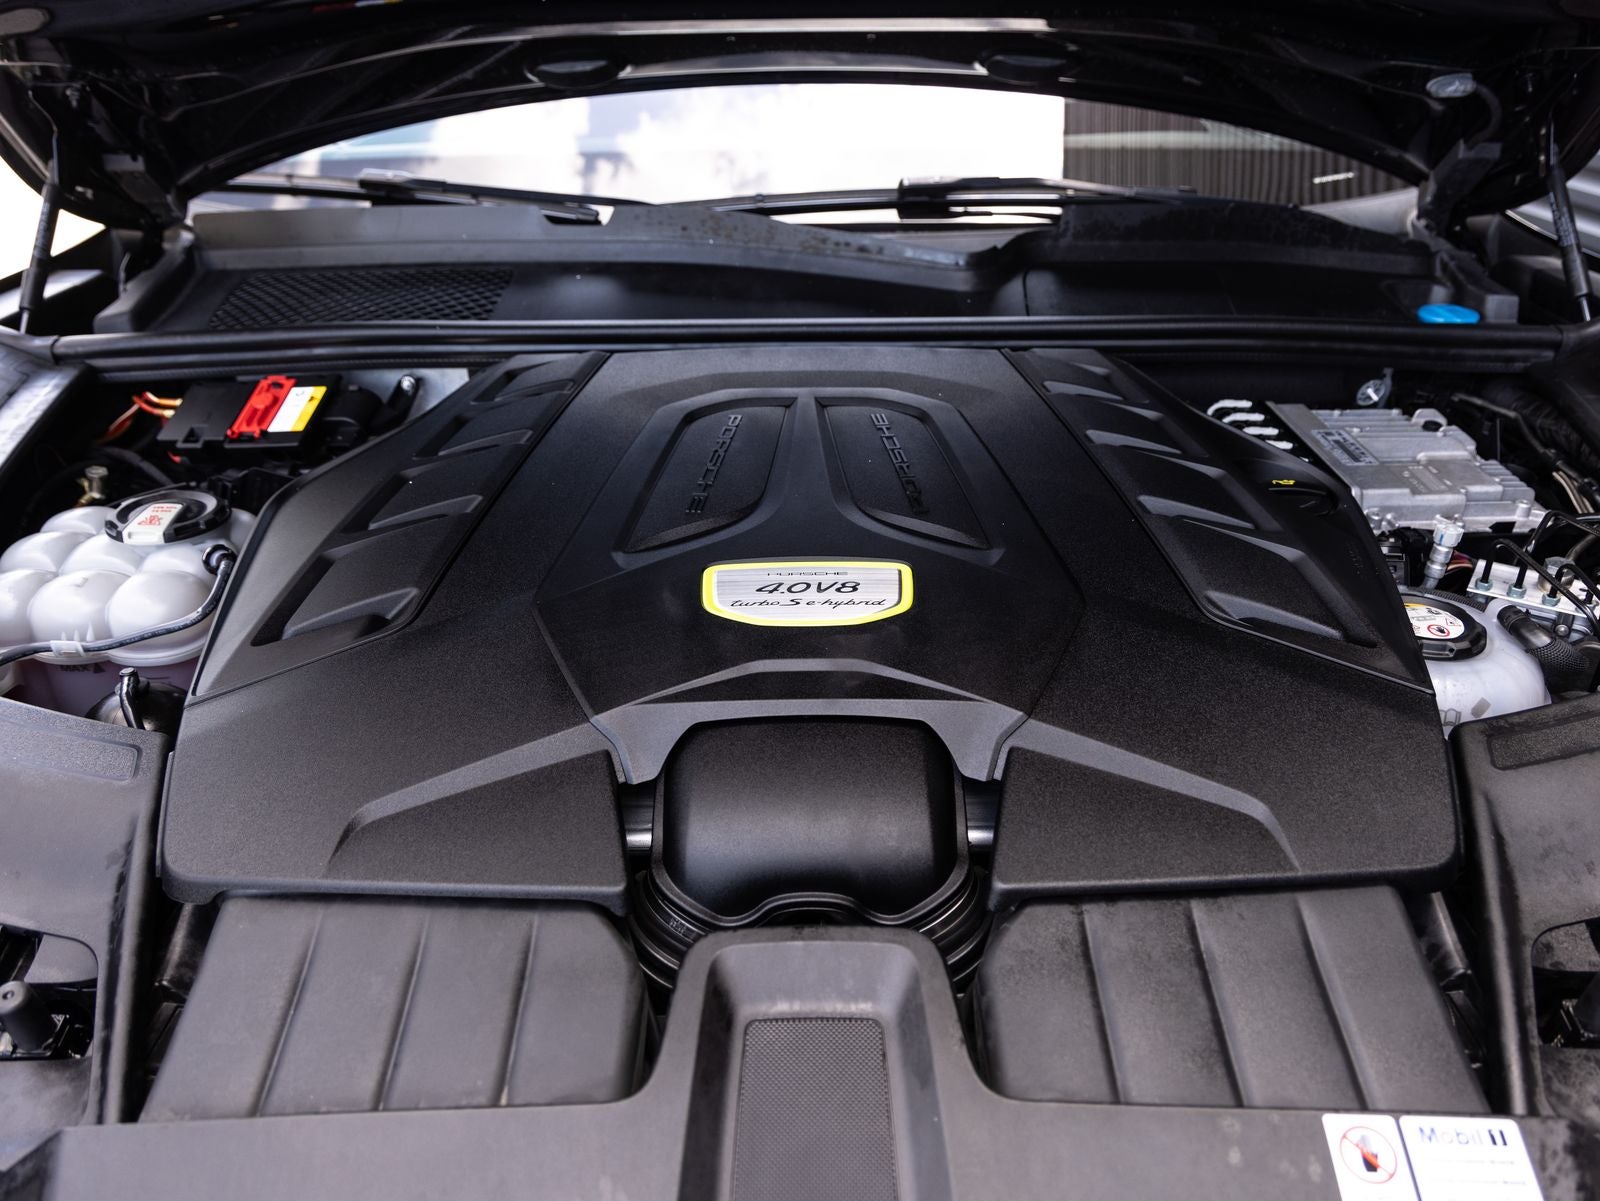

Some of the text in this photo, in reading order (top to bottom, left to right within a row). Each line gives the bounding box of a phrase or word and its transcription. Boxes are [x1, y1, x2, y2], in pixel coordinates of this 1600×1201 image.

[685, 414, 743, 513] PORSCHE
[870, 413, 930, 514] PORSCHE
[731, 598, 779, 607] turbo
[780, 598, 803, 607] S
[1418, 1126, 1484, 1146] Mobil
